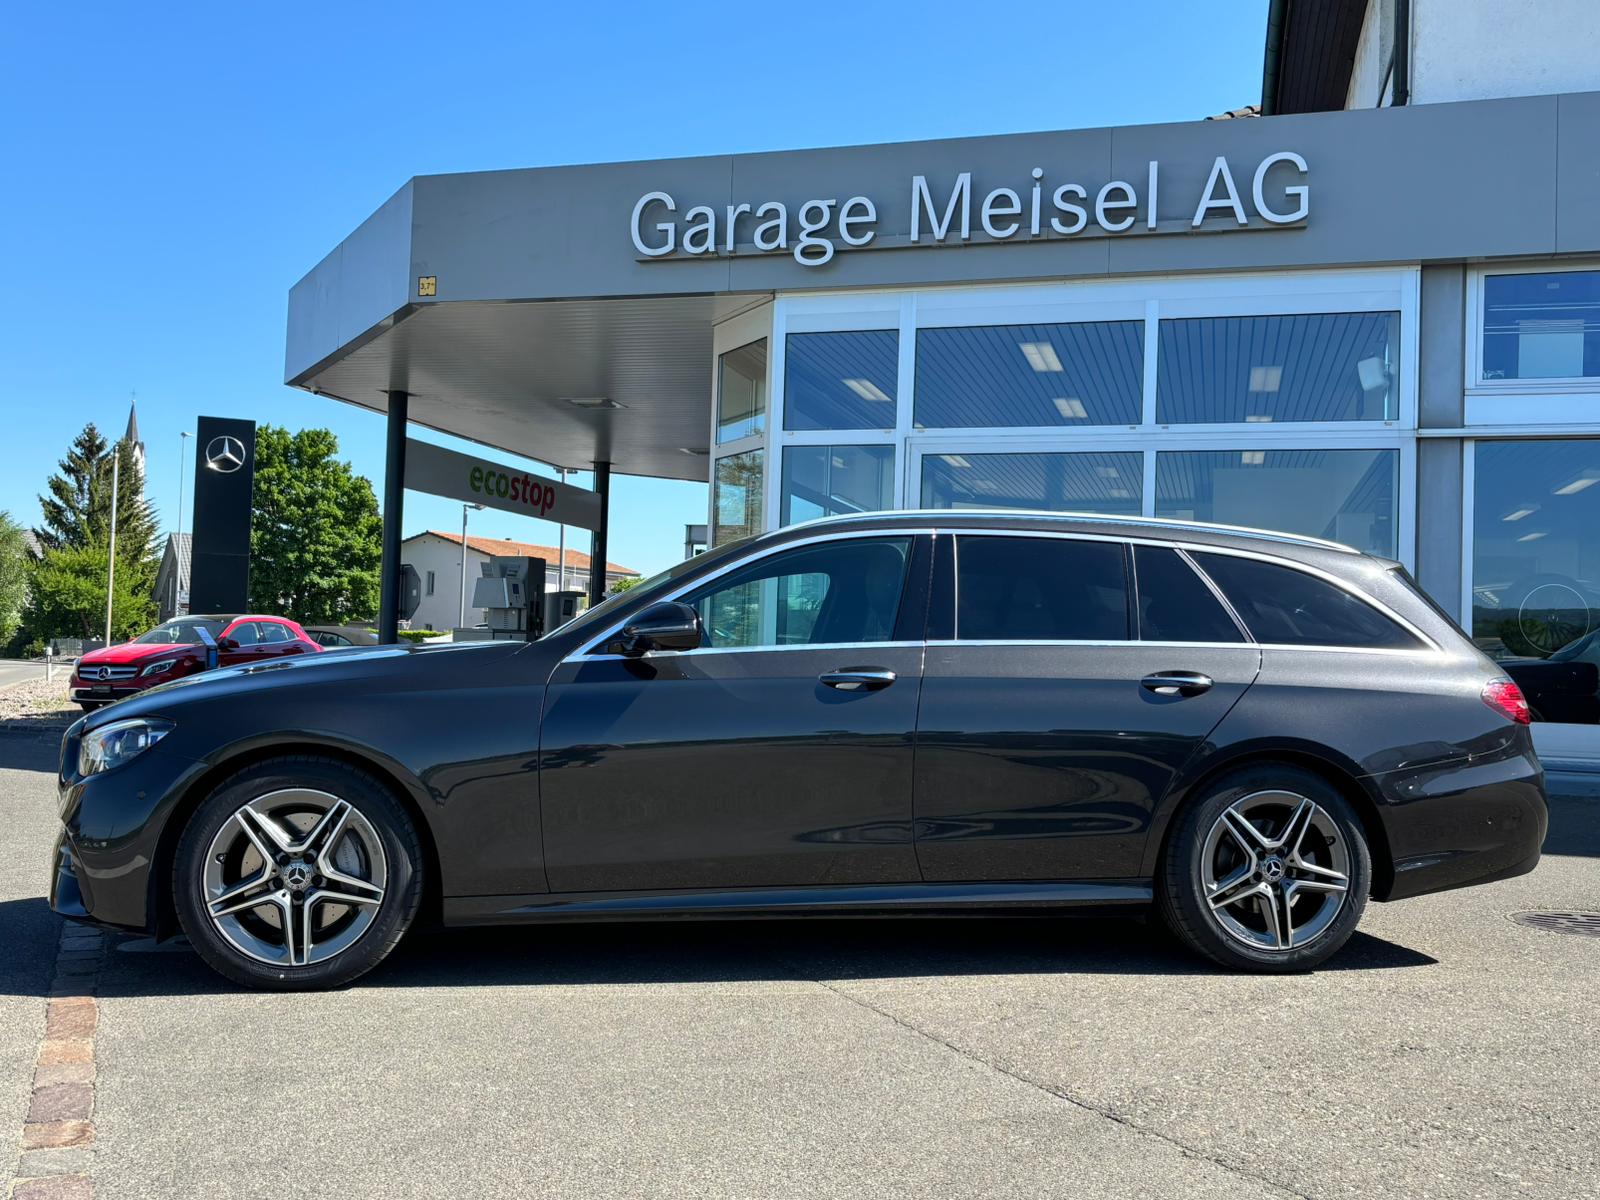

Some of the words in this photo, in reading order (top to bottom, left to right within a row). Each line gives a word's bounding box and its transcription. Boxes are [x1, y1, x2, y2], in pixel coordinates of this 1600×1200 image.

[630, 191, 877, 267] Garage
[910, 161, 1159, 242] Meisel
[1192, 151, 1310, 231] AG
[469, 466, 555, 516] ecostop
